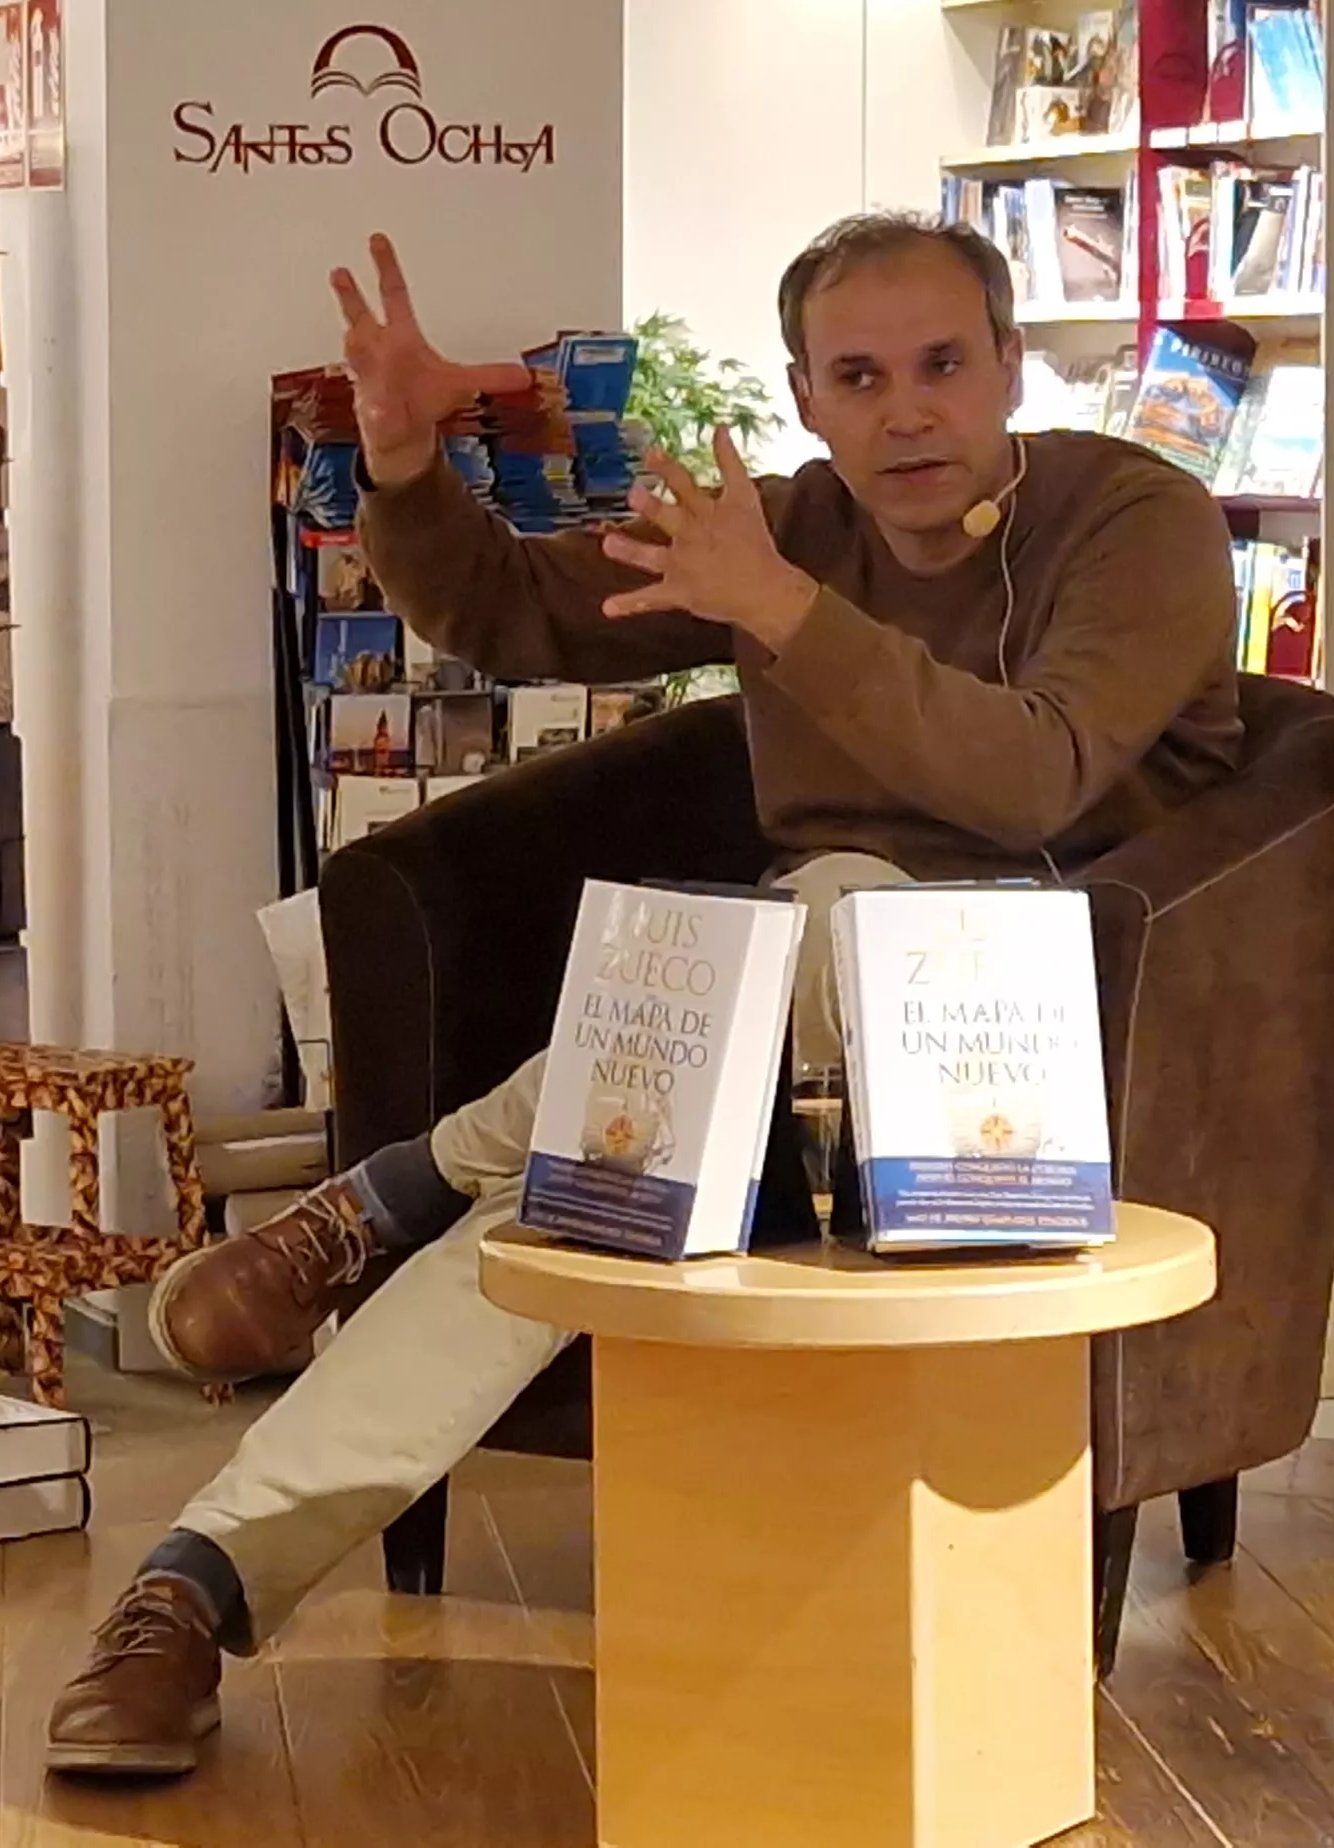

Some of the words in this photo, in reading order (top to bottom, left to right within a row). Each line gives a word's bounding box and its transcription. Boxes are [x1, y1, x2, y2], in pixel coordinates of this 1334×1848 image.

[629, 900, 704, 949] UIS
[596, 942, 716, 996] ZUECO
[584, 993, 603, 1018] EL
[609, 998, 672, 1032] MAPA
[681, 1009, 713, 1037] DE
[904, 1000, 930, 1024] EL
[942, 1000, 1025, 1025] MAPA
[575, 1021, 610, 1050] UN
[611, 1031, 708, 1069] MUNDO
[902, 1030, 947, 1055] UN
[590, 1058, 675, 1096] NUEVO
